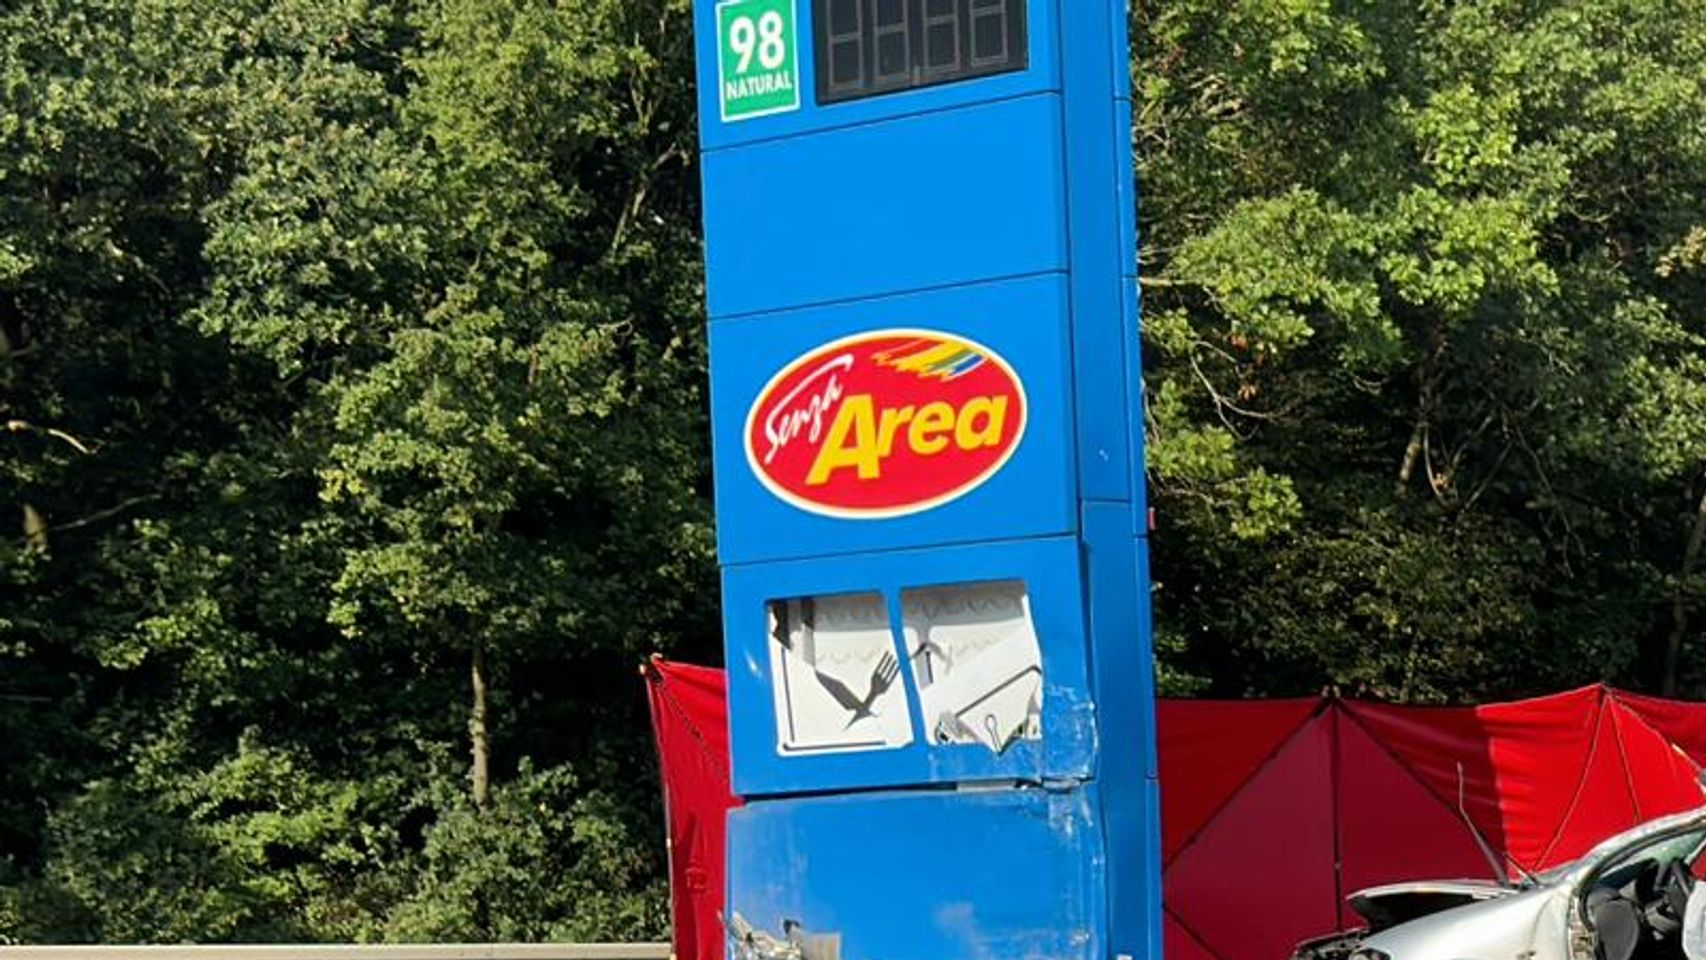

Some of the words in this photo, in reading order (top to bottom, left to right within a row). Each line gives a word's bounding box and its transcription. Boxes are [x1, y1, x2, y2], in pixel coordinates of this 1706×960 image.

[730, 10, 785, 74] 98
[726, 70, 793, 101] NATURAL
[805, 394, 1008, 486] Area
